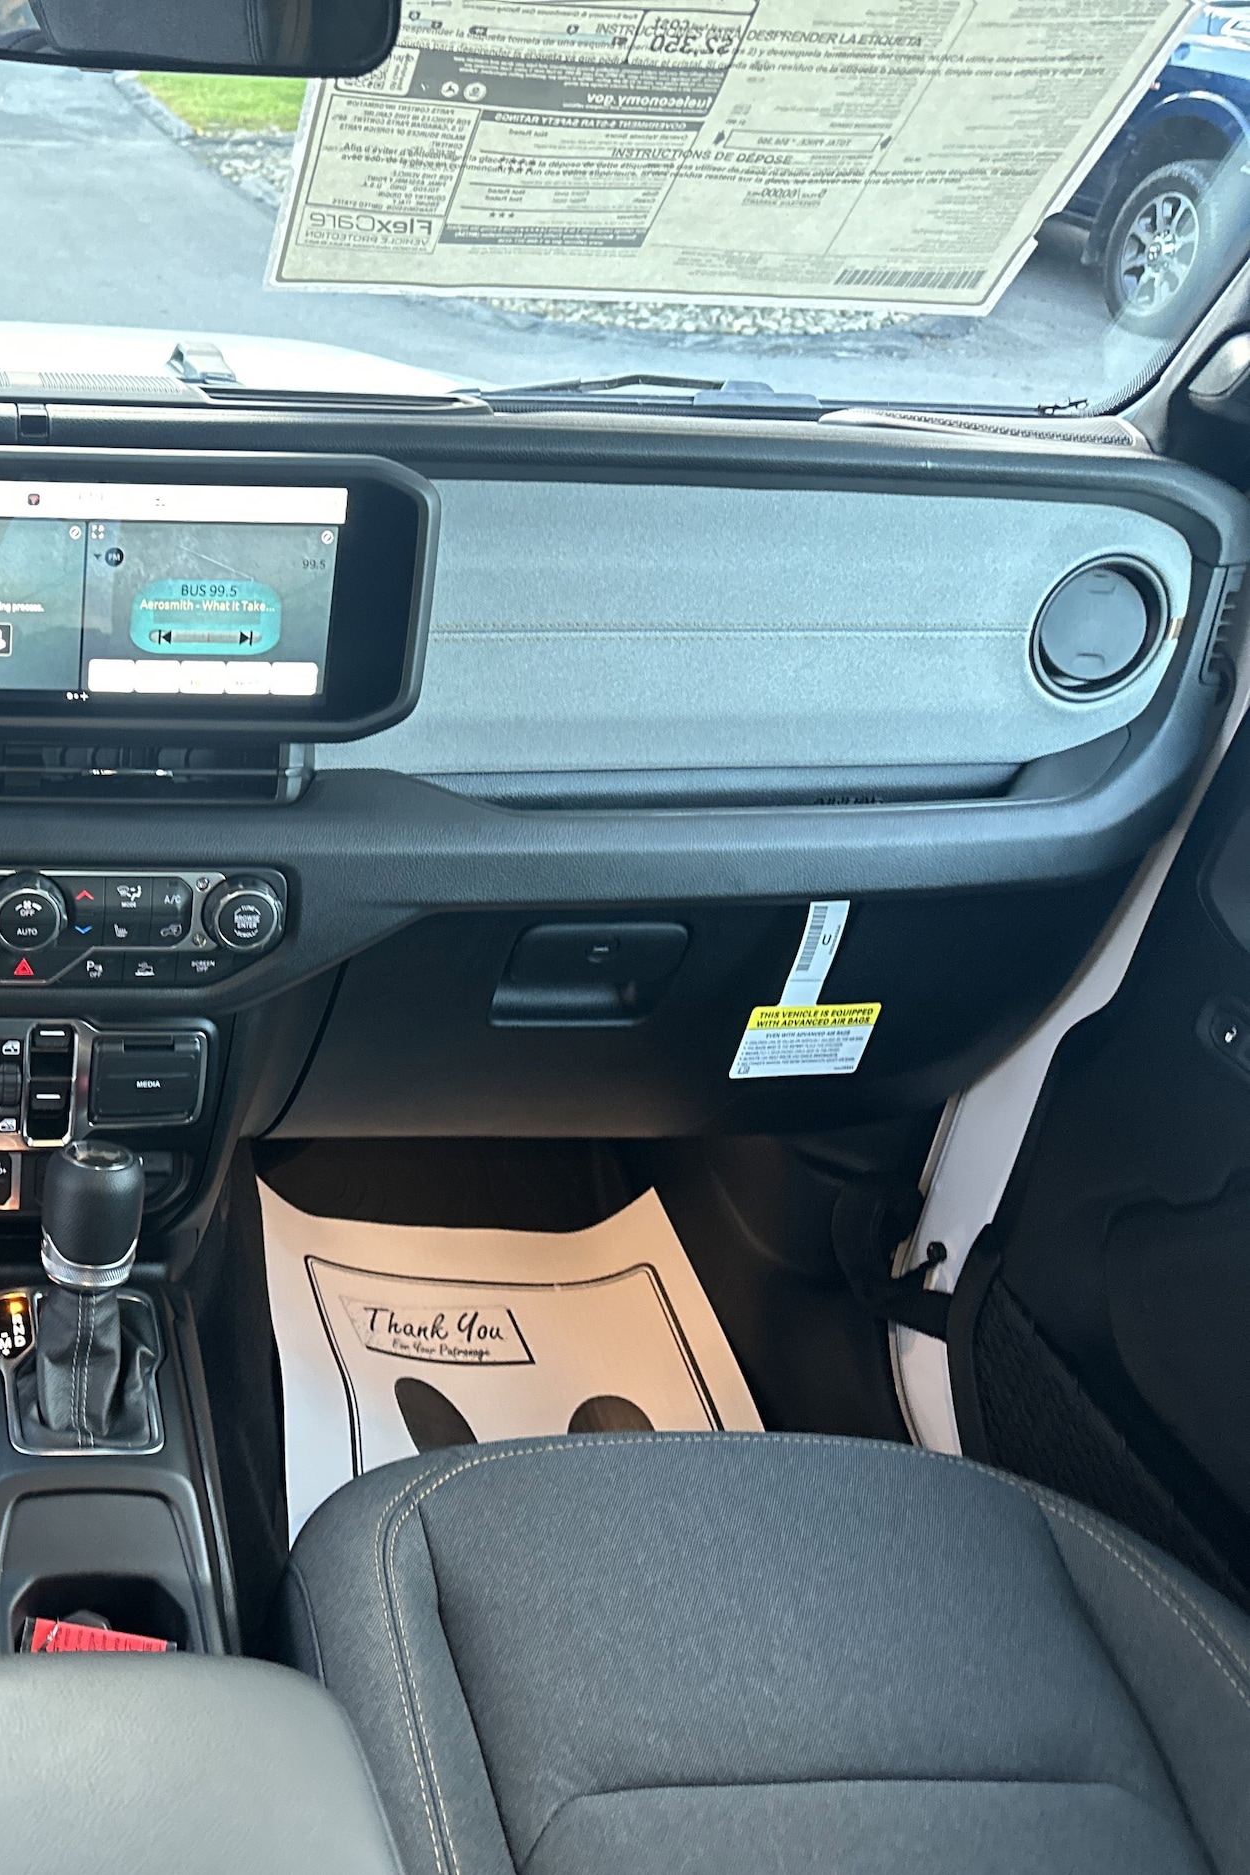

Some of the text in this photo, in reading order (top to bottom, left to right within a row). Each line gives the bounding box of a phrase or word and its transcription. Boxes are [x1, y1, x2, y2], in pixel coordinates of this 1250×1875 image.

[747, 30, 838, 45] DESPRENDER
[839, 32, 856, 45] LA
[858, 34, 922, 47] ETIQUETA
[611, 148, 794, 165] INSTRUCTIONS DE DÉPOSE
[302, 559, 327, 570] 99.5
[181, 584, 238, 598] BUS 99.5
[139, 599, 194, 613] Aerosmith
[202, 600, 230, 613] What
[241, 601, 276, 613] Take...
[121, 901, 137, 909] MODE
[164, 895, 182, 905] A/C
[20, 910, 35, 918] OFF
[16, 928, 38, 937] AUTO
[760, 1008, 874, 1020] THIS VEHICLE IS EQUIPPED
[757, 1016, 871, 1028] WITH ADVANCED AIR BAGS
[136, 1080, 161, 1090] MEDIA
[13, 1324, 25, 1336] N
[364, 1308, 504, 1343] Thank You
[14, 1335, 27, 1348] D
